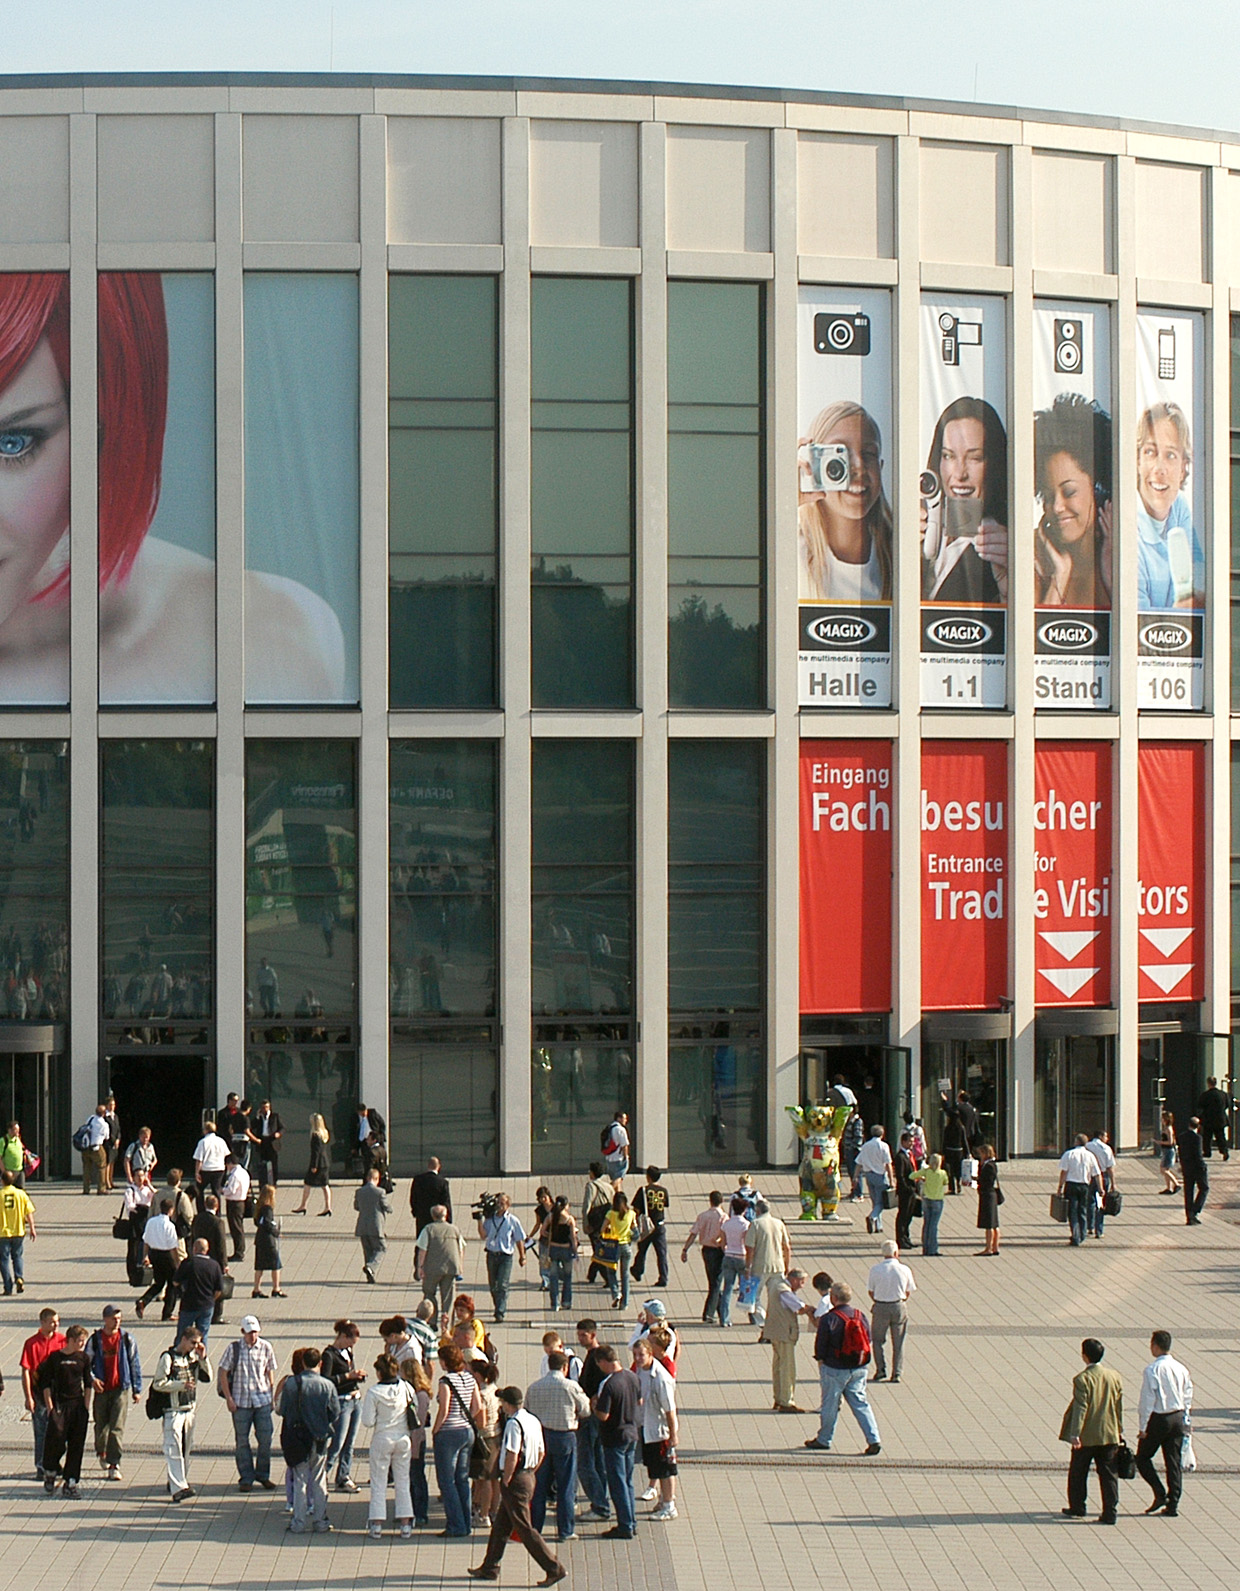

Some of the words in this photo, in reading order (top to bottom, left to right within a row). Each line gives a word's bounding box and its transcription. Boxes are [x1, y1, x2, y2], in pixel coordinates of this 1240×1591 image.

[819, 623, 864, 638] MAGIX
[938, 626, 981, 640] MAGIX
[1048, 628, 1088, 642] MAGIX
[1148, 630, 1183, 644] MAGIX
[855, 656, 890, 665] company
[930, 656, 970, 664] multimedia
[972, 657, 1005, 666] company
[809, 672, 877, 697] Halle
[942, 675, 977, 697] 1.1
[1035, 675, 1103, 699] Stand
[1148, 678, 1186, 700] 106
[812, 763, 890, 788] Eingang
[928, 854, 1003, 873] Entrance
[1033, 851, 1057, 872] for
